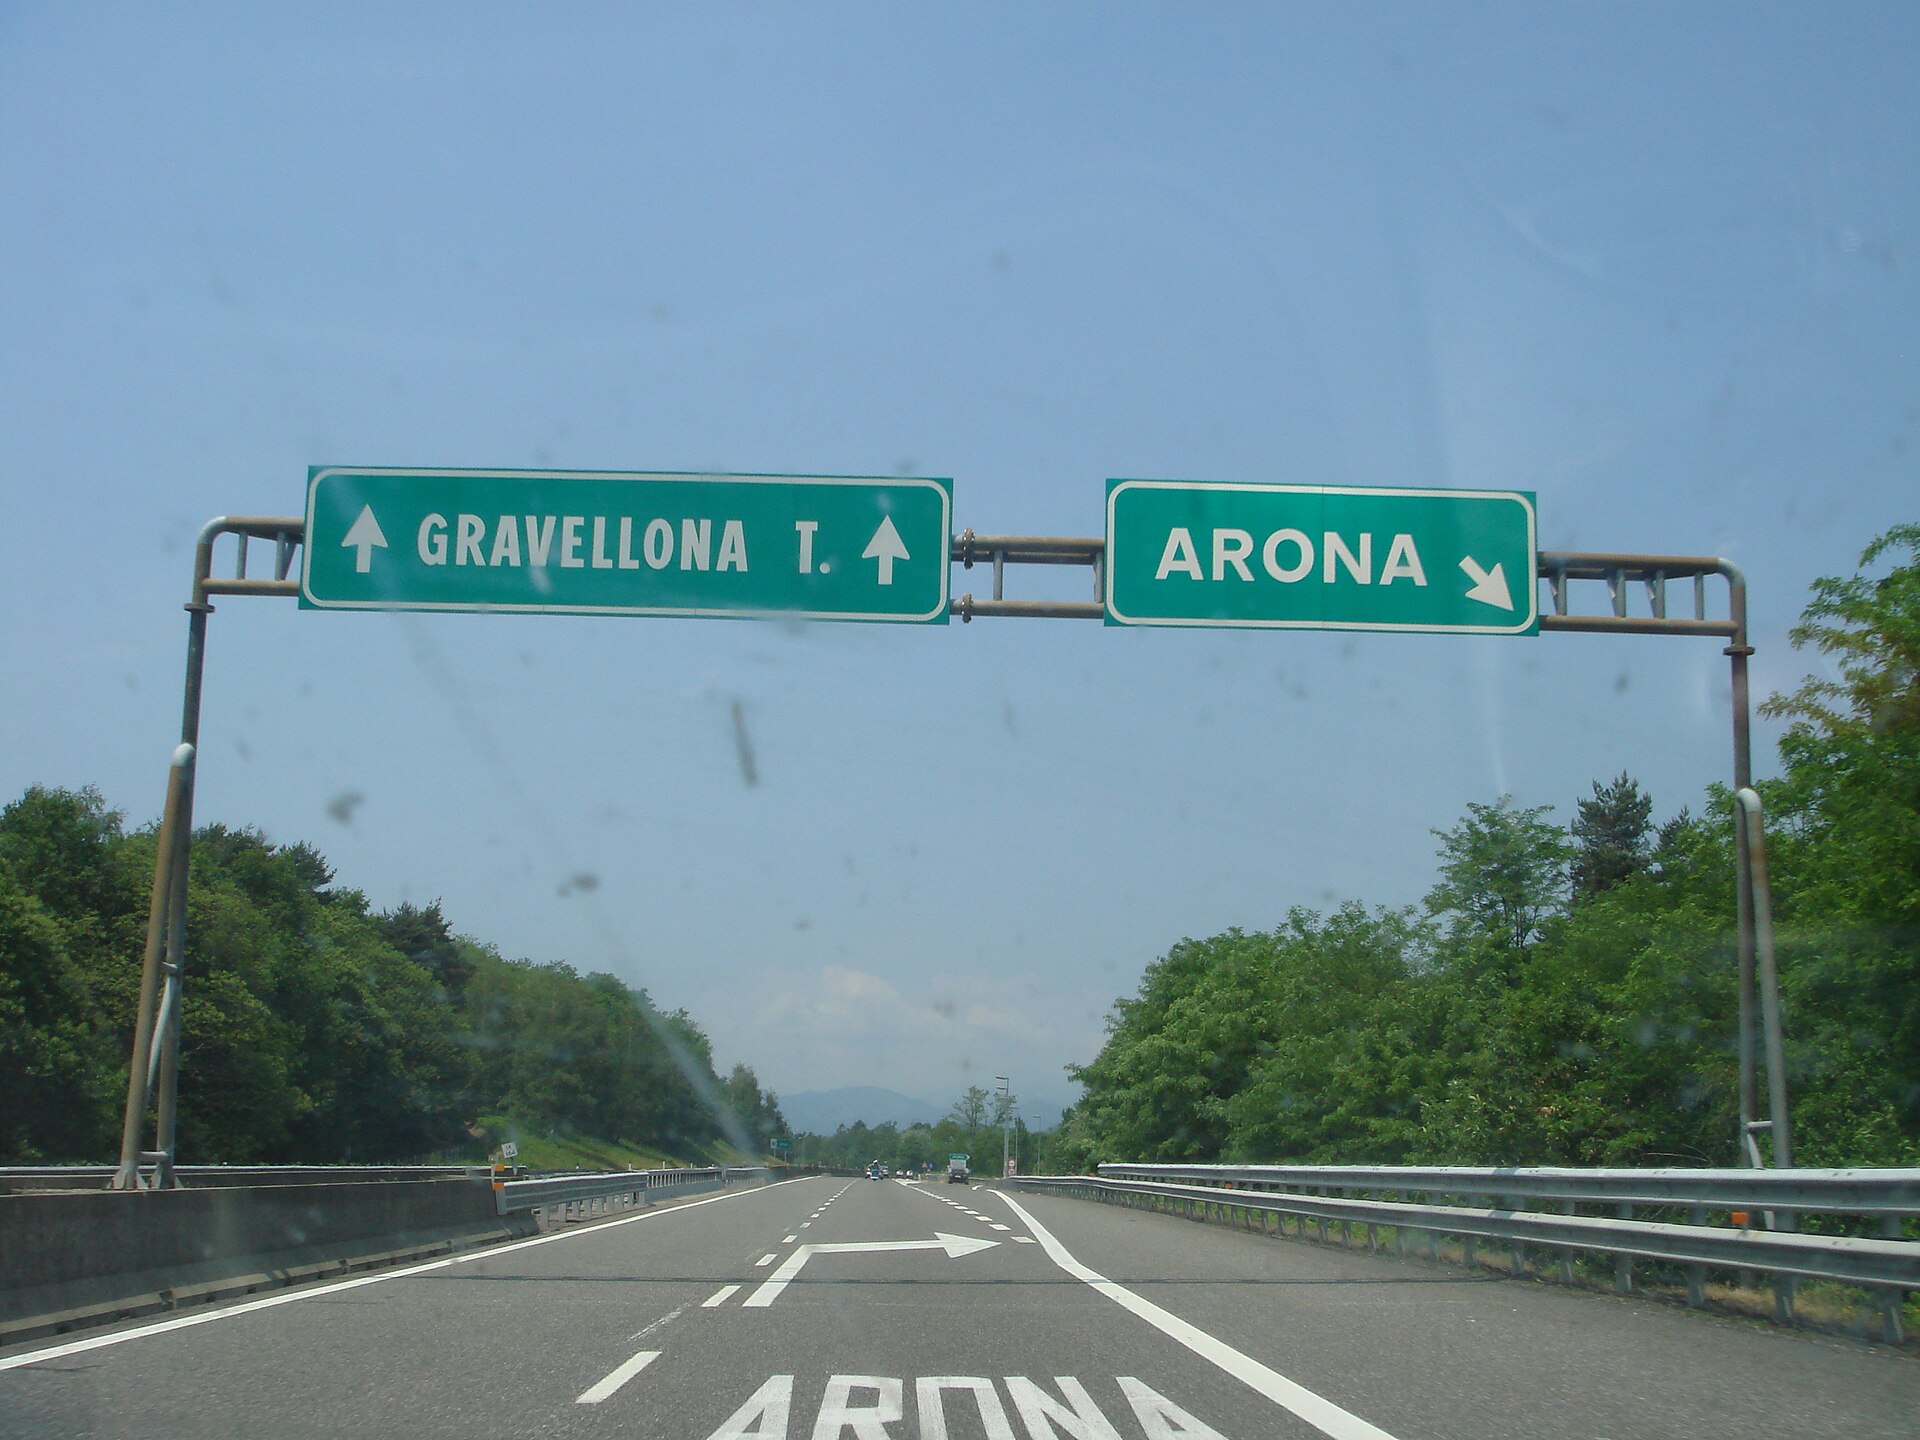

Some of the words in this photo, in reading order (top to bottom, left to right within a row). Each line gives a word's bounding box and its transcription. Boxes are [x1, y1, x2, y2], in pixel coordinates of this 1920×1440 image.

[417, 513, 748, 572] GRAVELLONA
[795, 521, 831, 574] T.
[1155, 528, 1428, 586] ARONA
